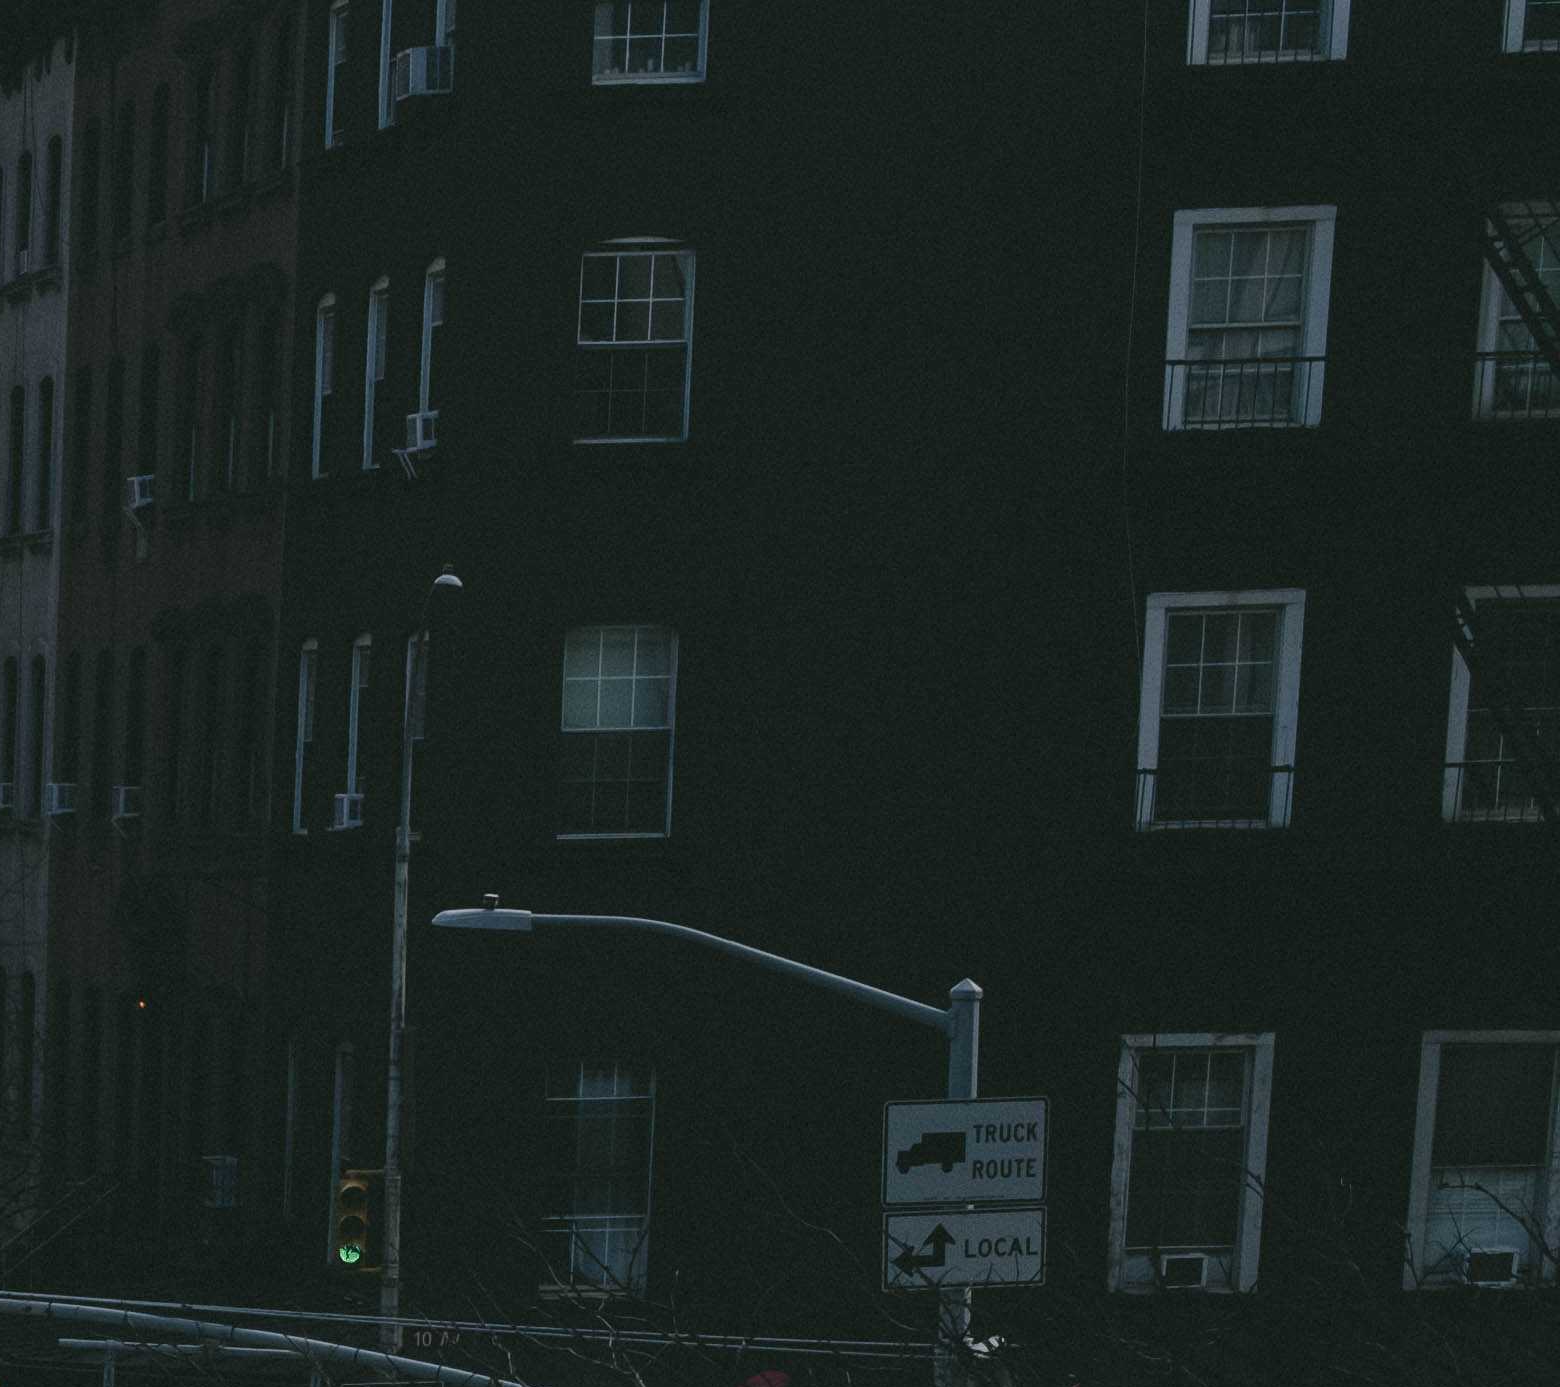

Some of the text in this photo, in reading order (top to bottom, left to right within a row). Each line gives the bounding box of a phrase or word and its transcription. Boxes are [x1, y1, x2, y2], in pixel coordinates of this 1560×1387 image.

[972, 1122, 1038, 1143] TRUCK
[972, 1159, 1038, 1179] ROUTE
[964, 1236, 1038, 1258] LOCAL
[413, 1330, 433, 1347] 10
